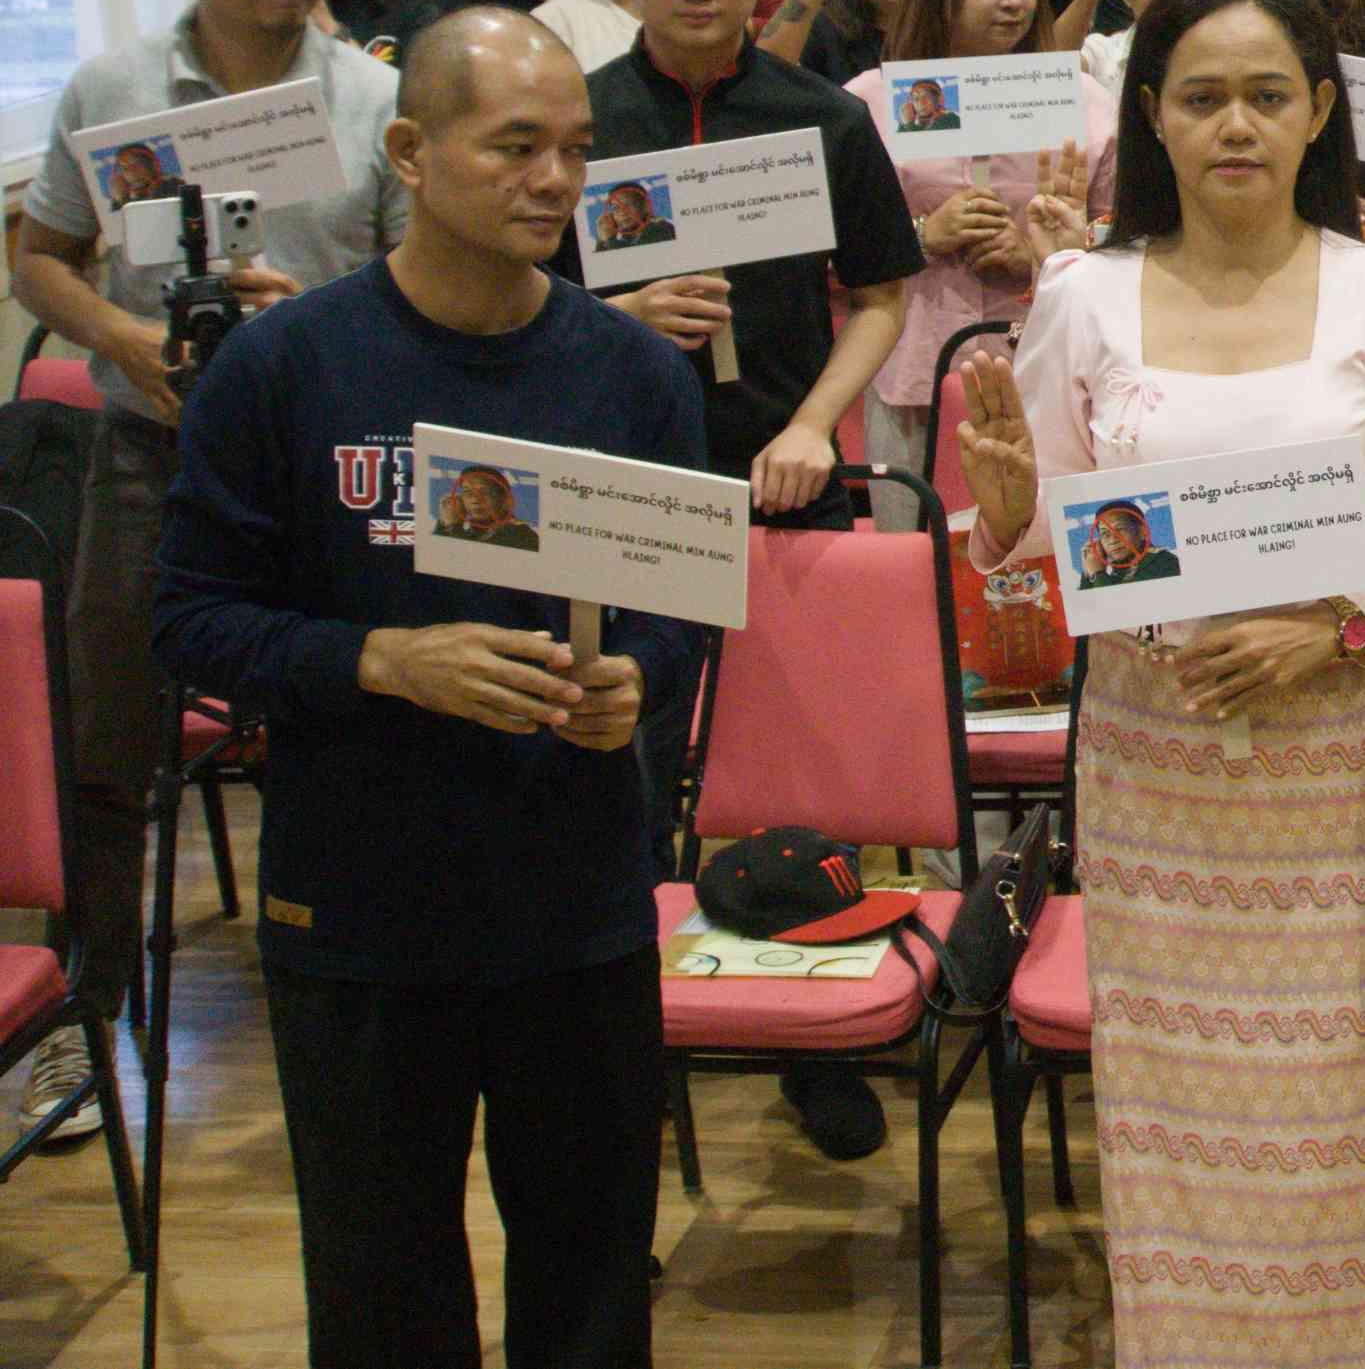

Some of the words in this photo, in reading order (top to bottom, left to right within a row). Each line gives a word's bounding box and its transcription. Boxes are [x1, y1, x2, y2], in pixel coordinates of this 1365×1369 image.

[548, 519, 562, 530] NO
[565, 522, 593, 536] PLACE
[595, 528, 612, 540] FOR
[615, 532, 635, 544] WAR
[637, 536, 682, 553] CRIMINAL
[685, 545, 704, 557] MIN
[707, 549, 732, 562] AUNG
[1184, 535, 1199, 546] NO
[1201, 531, 1228, 543] PLACE
[1229, 528, 1246, 539] FOR
[1248, 525, 1268, 536] WAR
[1269, 518, 1313, 533] CRIMINAL
[1315, 515, 1334, 527] MIN
[1336, 511, 1362, 524] AUNG
[1257, 538, 1295, 553] HLAING!
